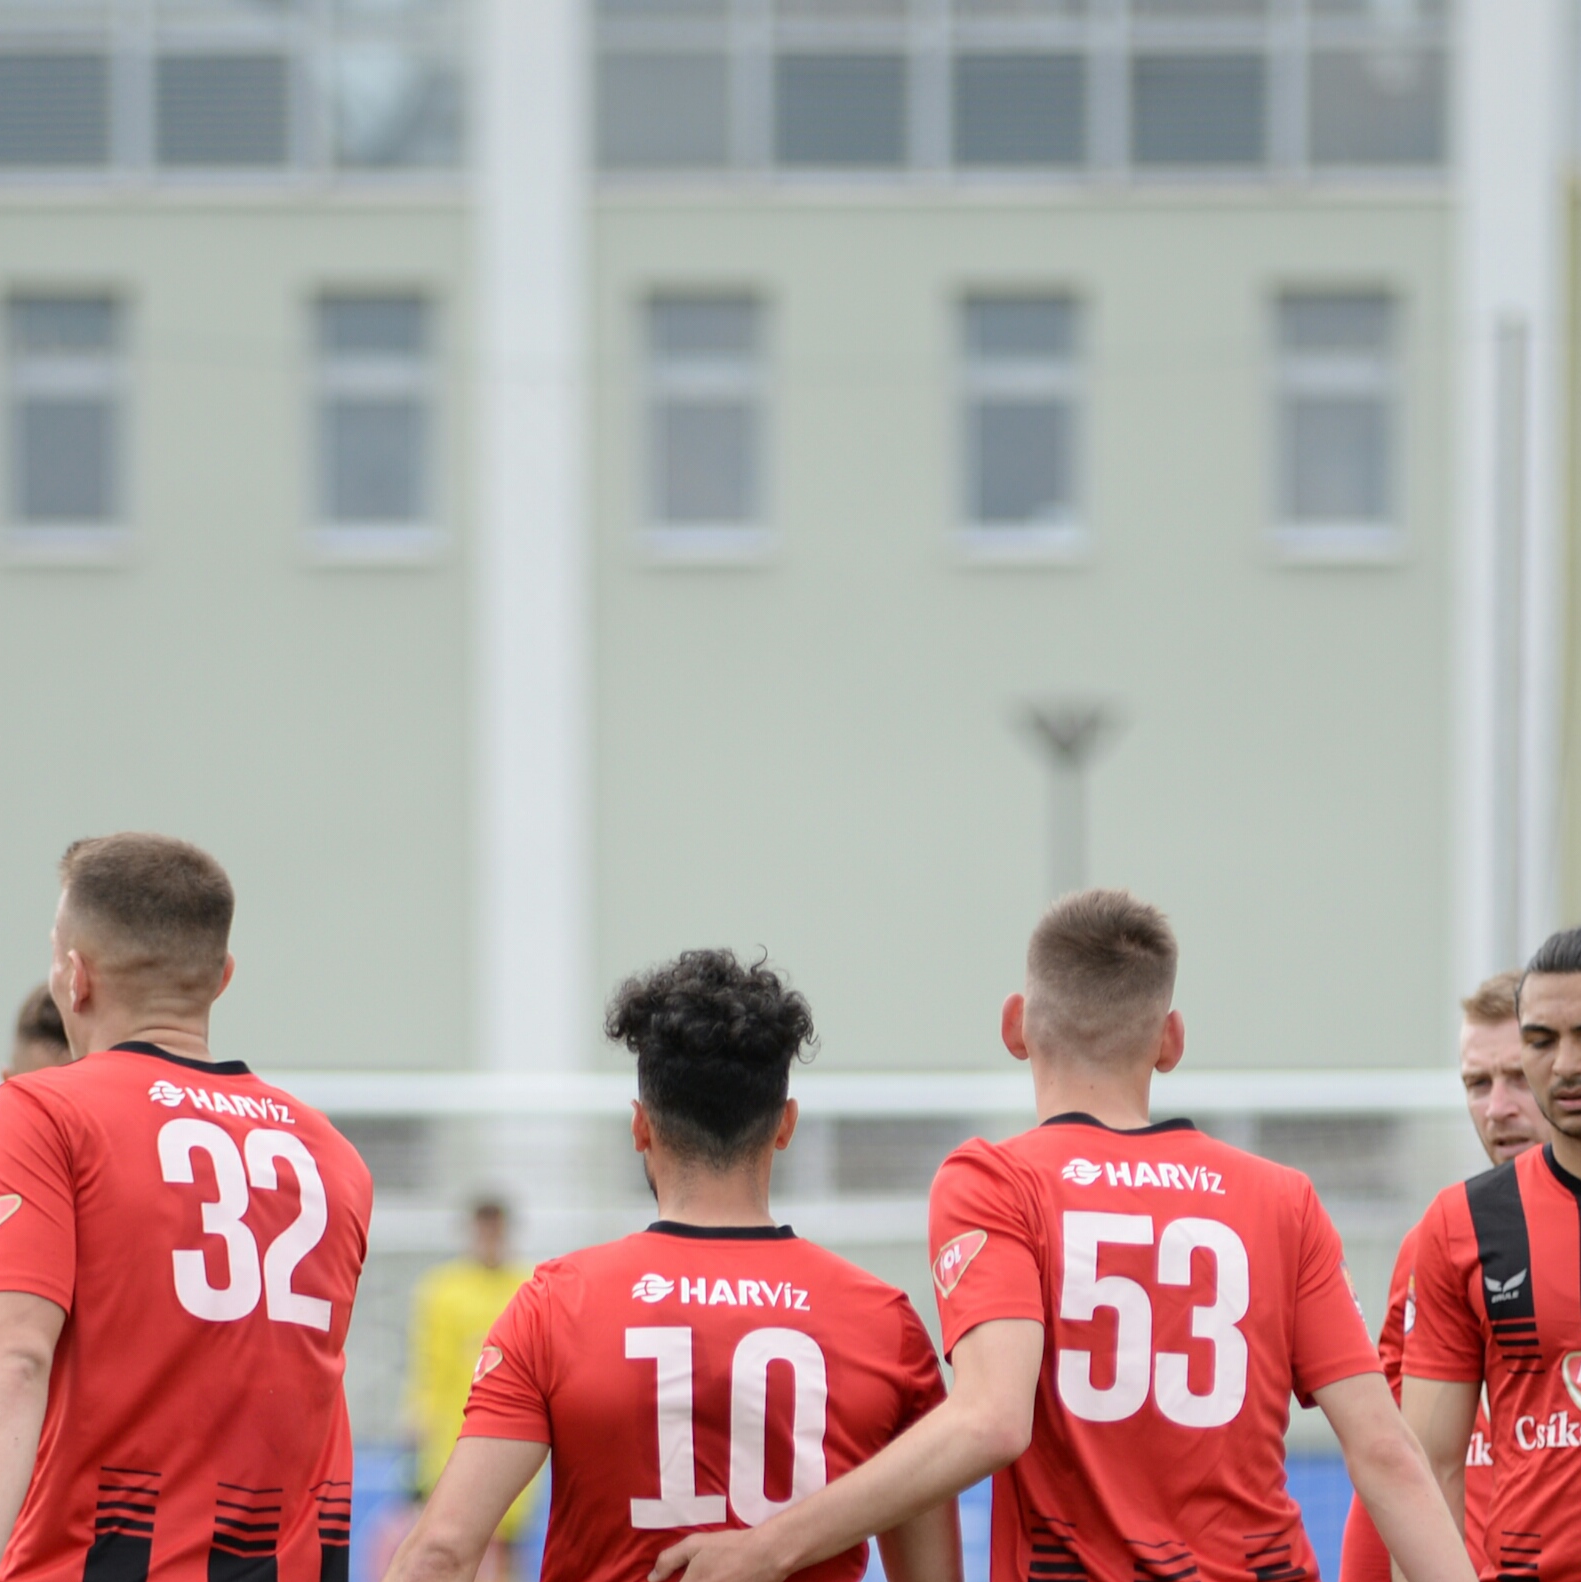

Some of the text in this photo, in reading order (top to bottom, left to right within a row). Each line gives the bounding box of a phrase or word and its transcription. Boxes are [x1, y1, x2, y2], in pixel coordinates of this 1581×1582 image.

[157, 1117, 333, 1332] 32
[1057, 1210, 1250, 1428] 53
[624, 1326, 828, 1530] 10
